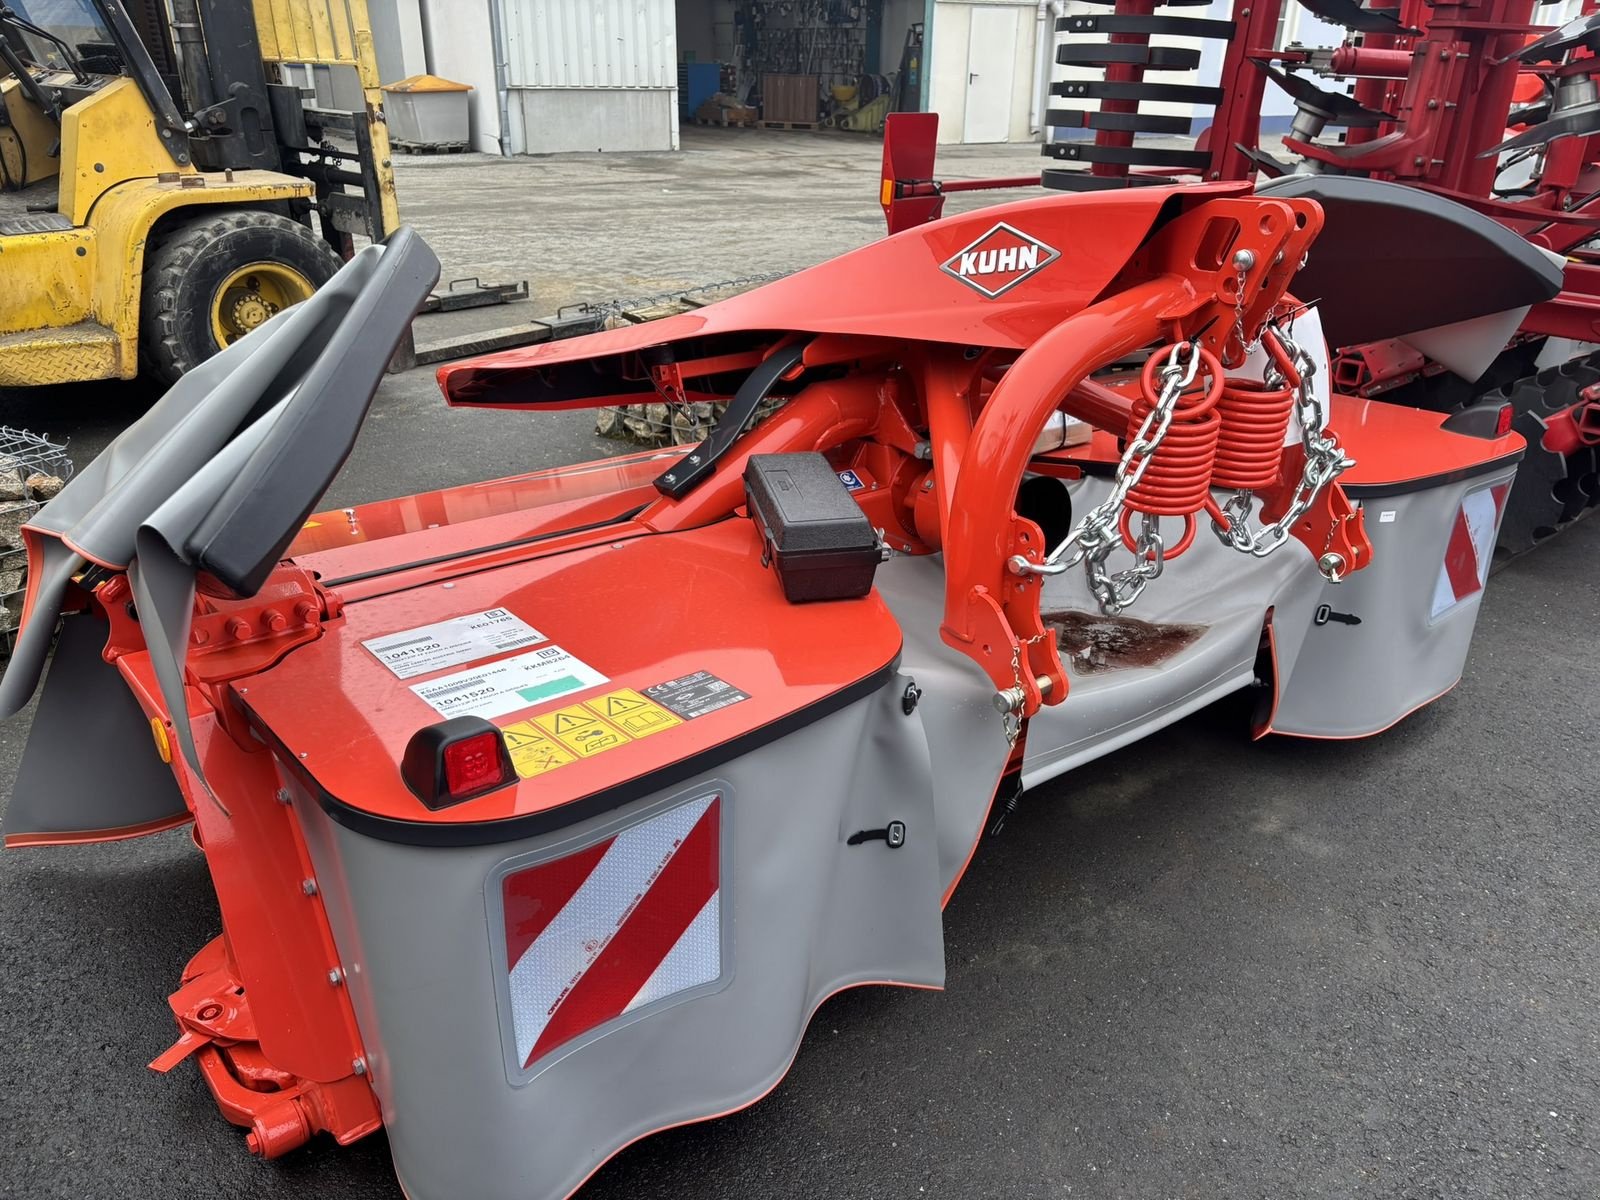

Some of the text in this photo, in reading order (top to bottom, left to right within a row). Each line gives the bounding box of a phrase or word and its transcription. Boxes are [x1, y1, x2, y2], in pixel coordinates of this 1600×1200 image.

[960, 245, 1038, 276] KUHN
[384, 642, 441, 660] 1041520
[542, 649, 555, 657] ID
[436, 687, 495, 706] 1041520
